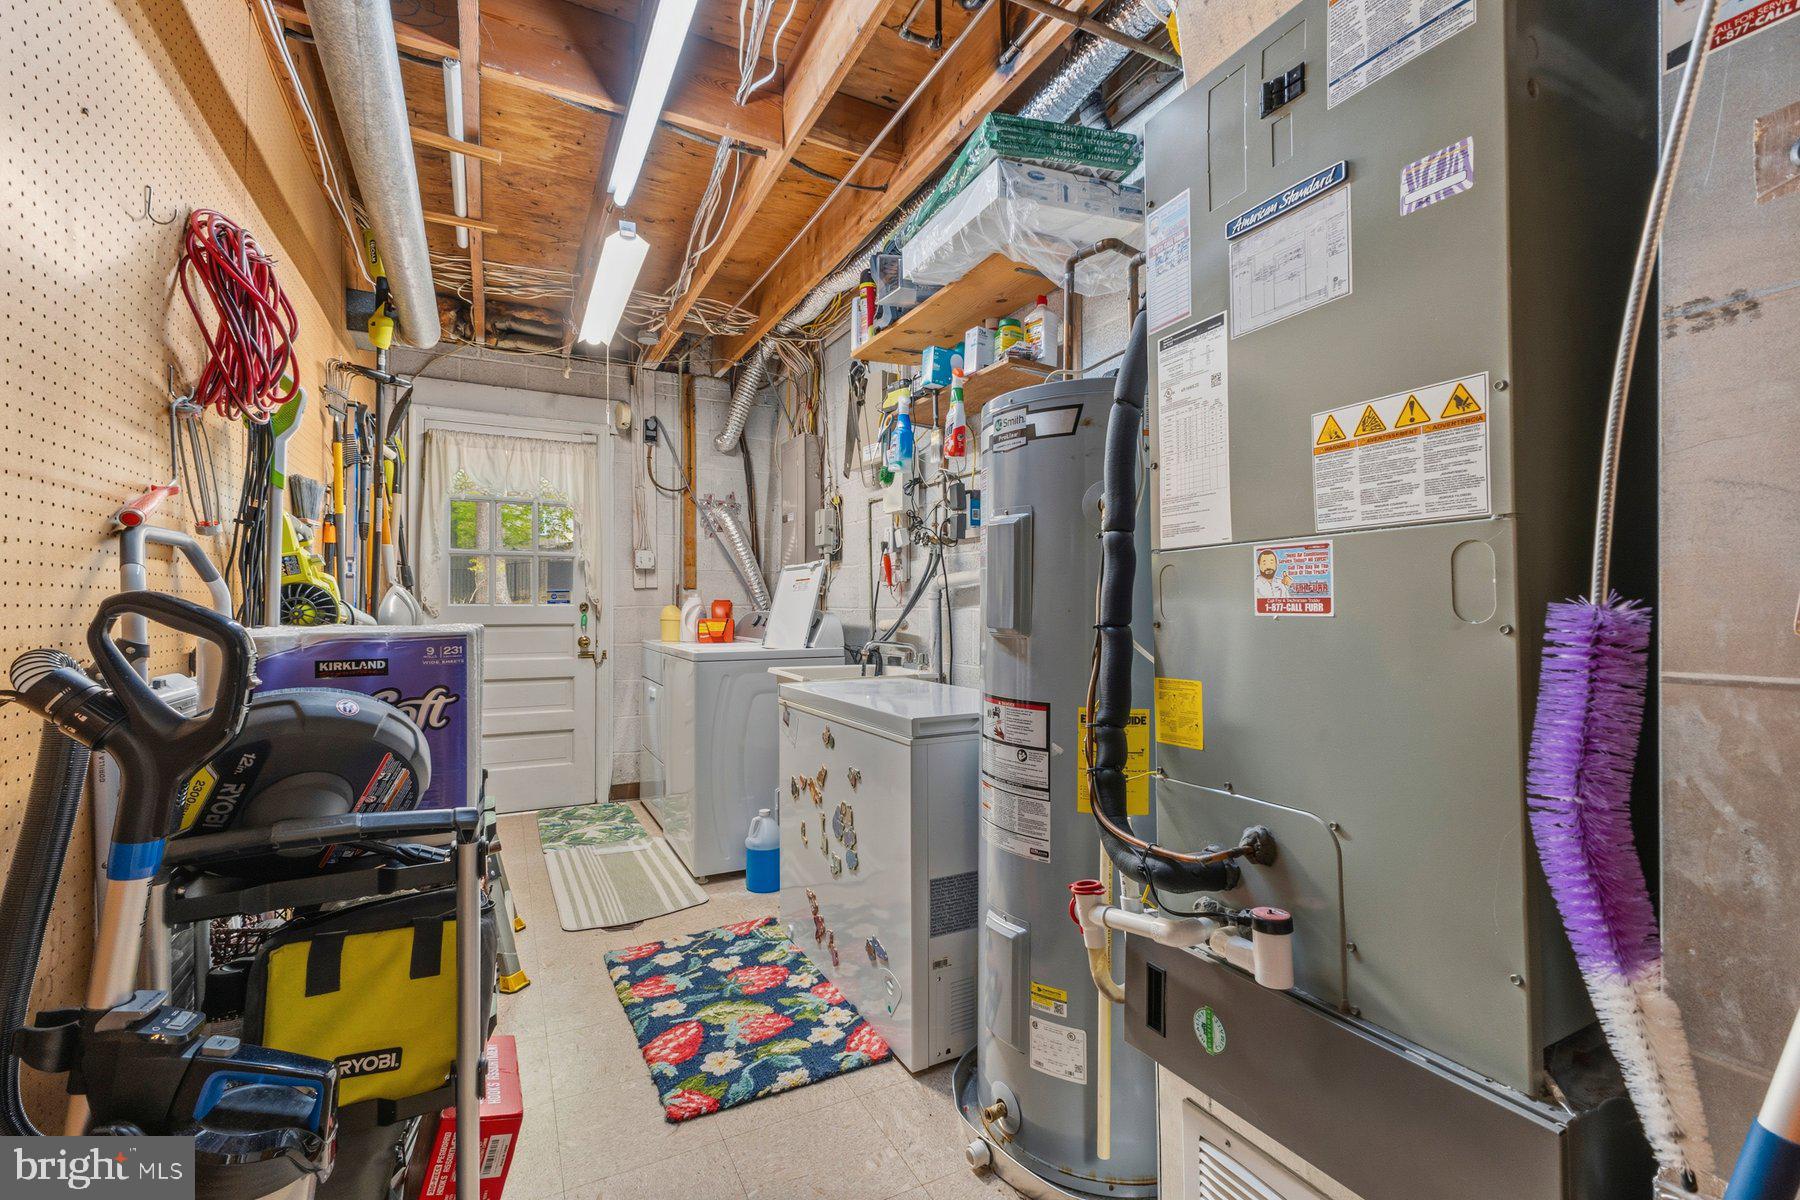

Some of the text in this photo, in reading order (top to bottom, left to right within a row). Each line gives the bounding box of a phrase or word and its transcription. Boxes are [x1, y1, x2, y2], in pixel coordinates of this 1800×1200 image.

[1714, 23, 1732, 35] ALL
[1734, 11, 1755, 26] FOR
[1714, 4, 1793, 45] 1-877-CALL
[1232, 167, 1336, 234] American Standard
[1003, 415, 1025, 428] Smith
[1432, 415, 1484, 431] ADVERTENCIA
[1265, 602, 1324, 612] 1-877-CALL FURR
[426, 645, 463, 655] 9 231
[319, 660, 386, 671] KIRKLAND
[187, 780, 206, 804] 2300
[202, 783, 246, 828] RYOBI
[338, 1052, 397, 1076] RYOBI
